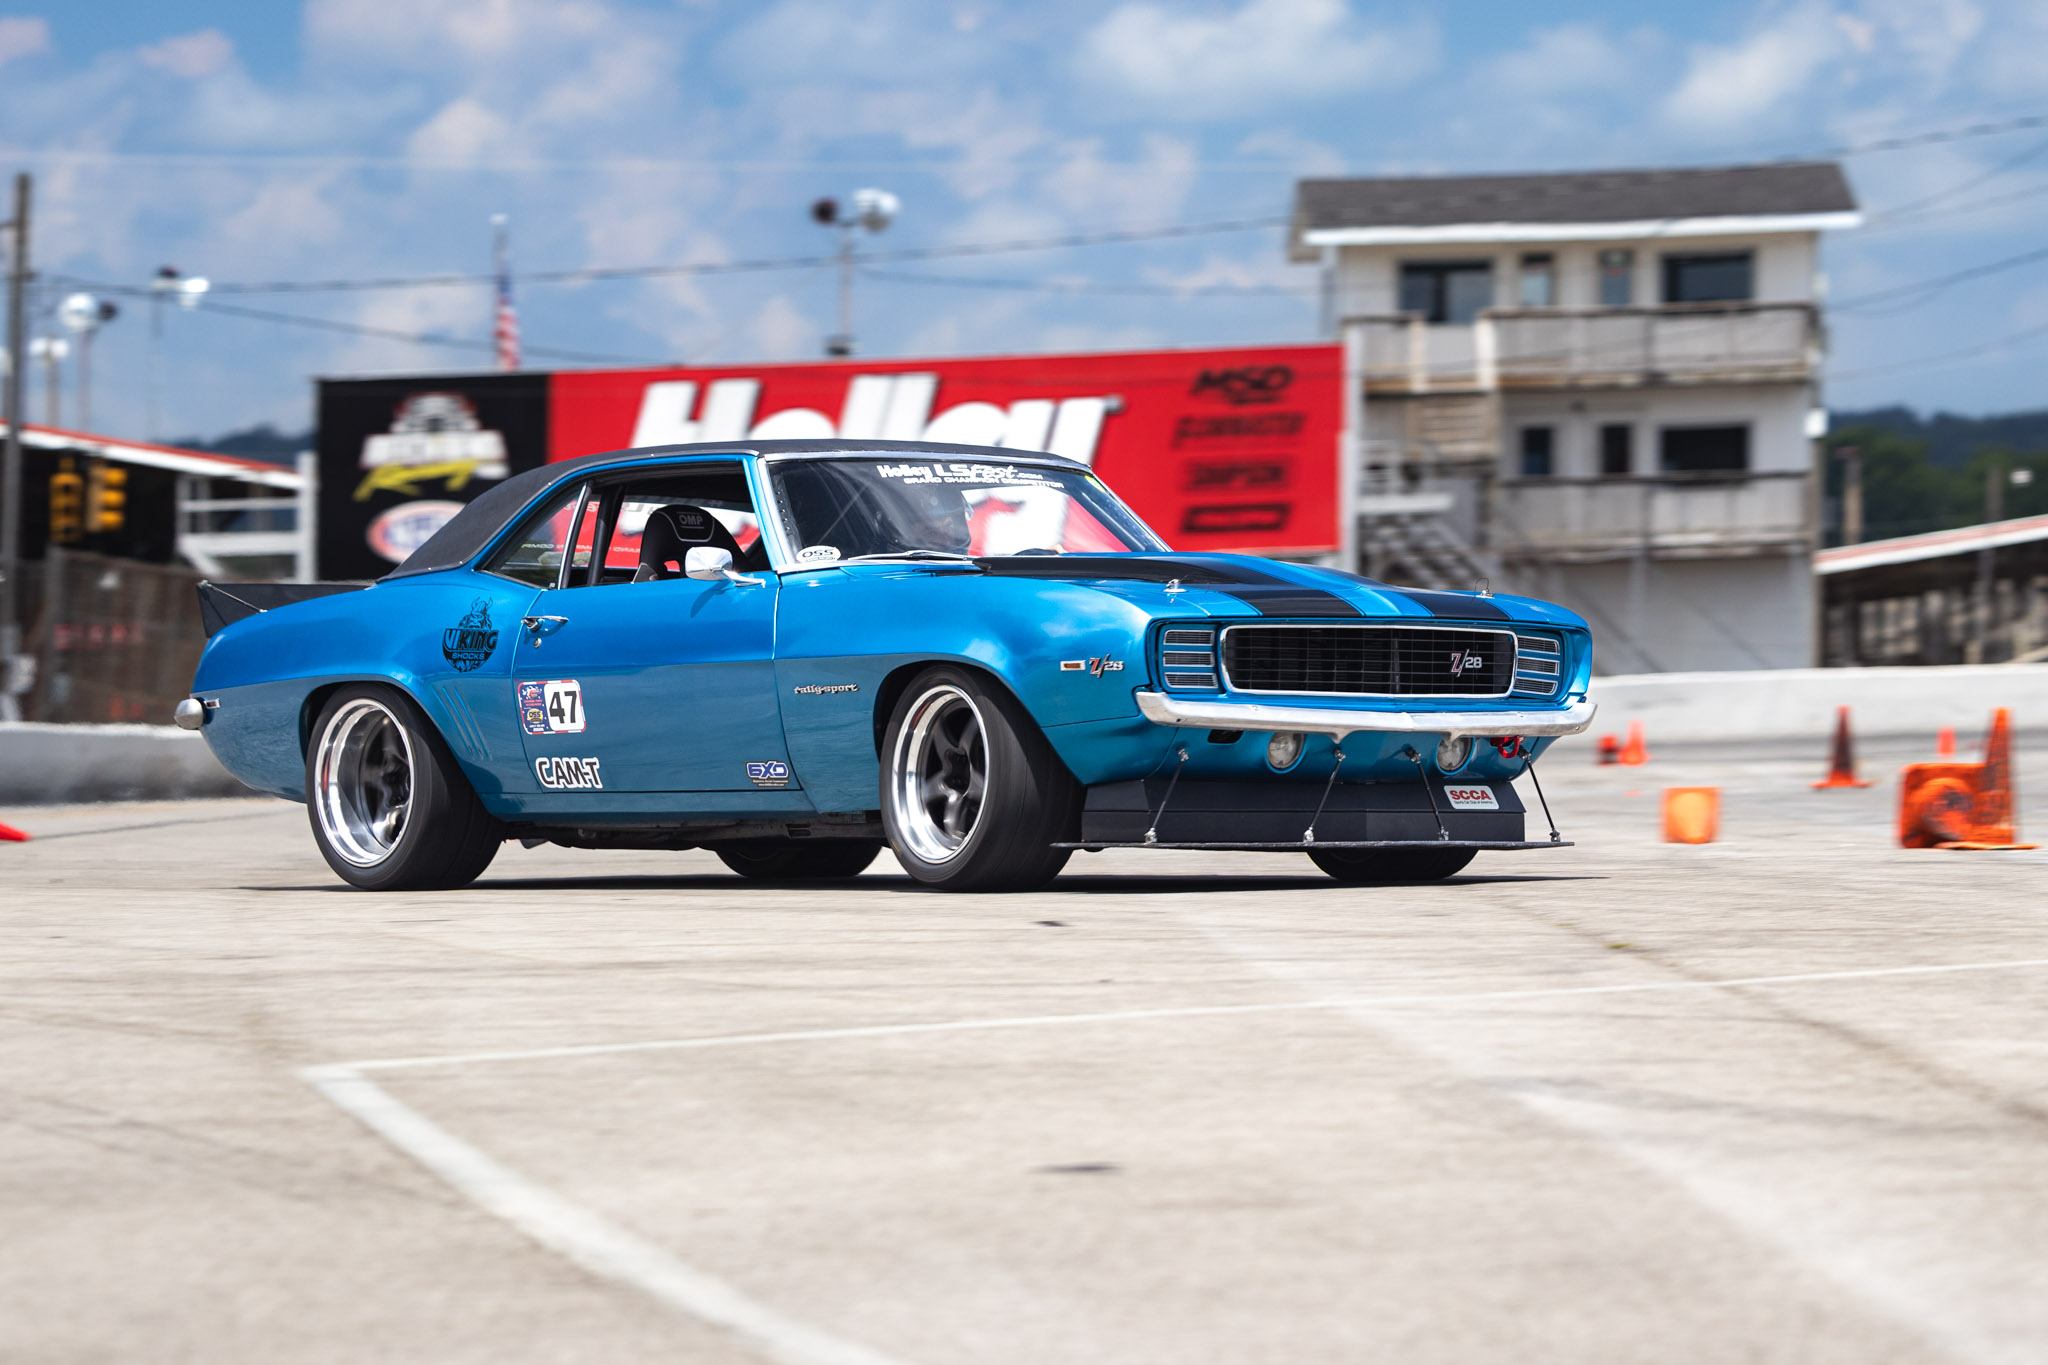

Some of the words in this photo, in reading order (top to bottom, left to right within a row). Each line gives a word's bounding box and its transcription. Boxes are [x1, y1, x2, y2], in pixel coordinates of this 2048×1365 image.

[876, 464, 933, 481] Holley
[943, 476, 999, 484] CHAMPION
[1001, 478, 1064, 488] COMPETITOR
[679, 514, 703, 526] OMP
[802, 549, 833, 557] OSS
[443, 628, 499, 652] VIKING
[1451, 648, 1483, 678] Z/28
[549, 691, 577, 724] 47
[536, 757, 603, 789] CAM-T
[1450, 790, 1492, 800] SCCA
